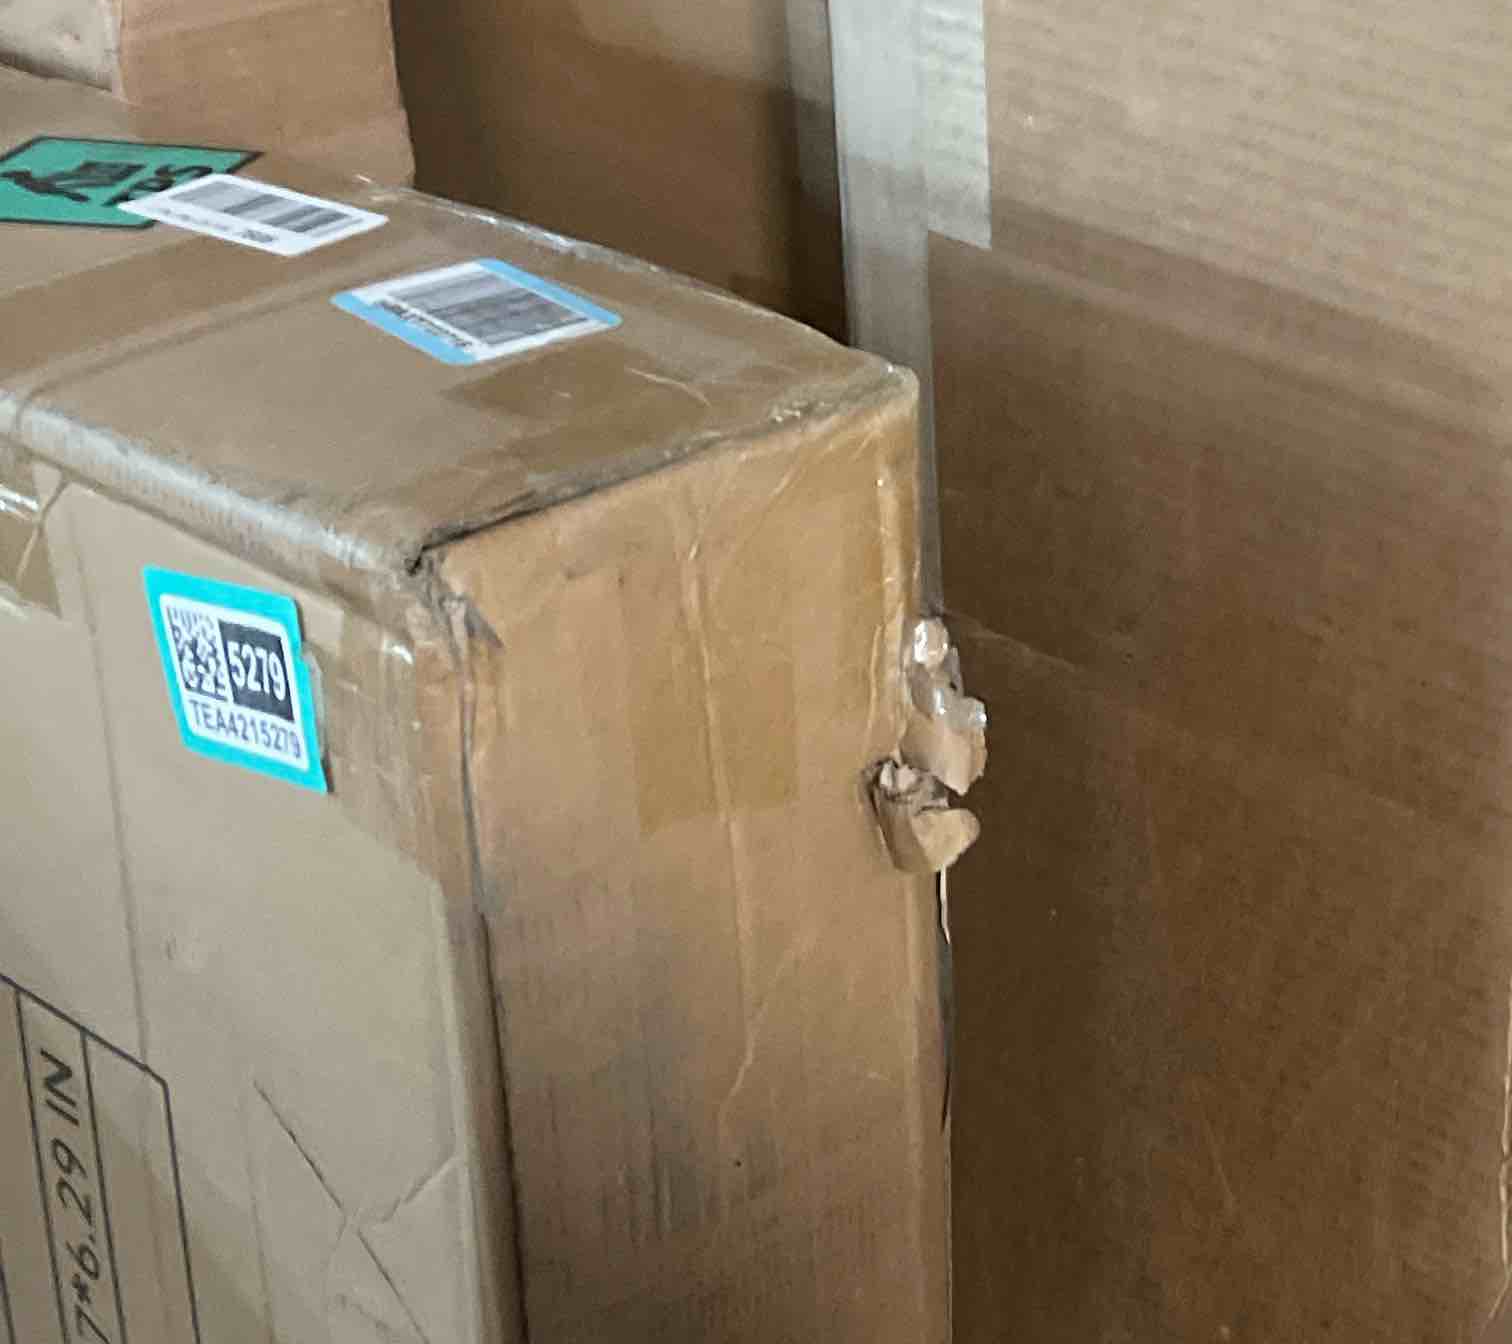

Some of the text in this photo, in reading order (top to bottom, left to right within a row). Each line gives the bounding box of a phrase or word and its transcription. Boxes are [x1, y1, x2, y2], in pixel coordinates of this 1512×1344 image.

[226, 641, 286, 702] 5279
[189, 699, 301, 758] TEA4215279
[39, 1047, 80, 1127] IN
